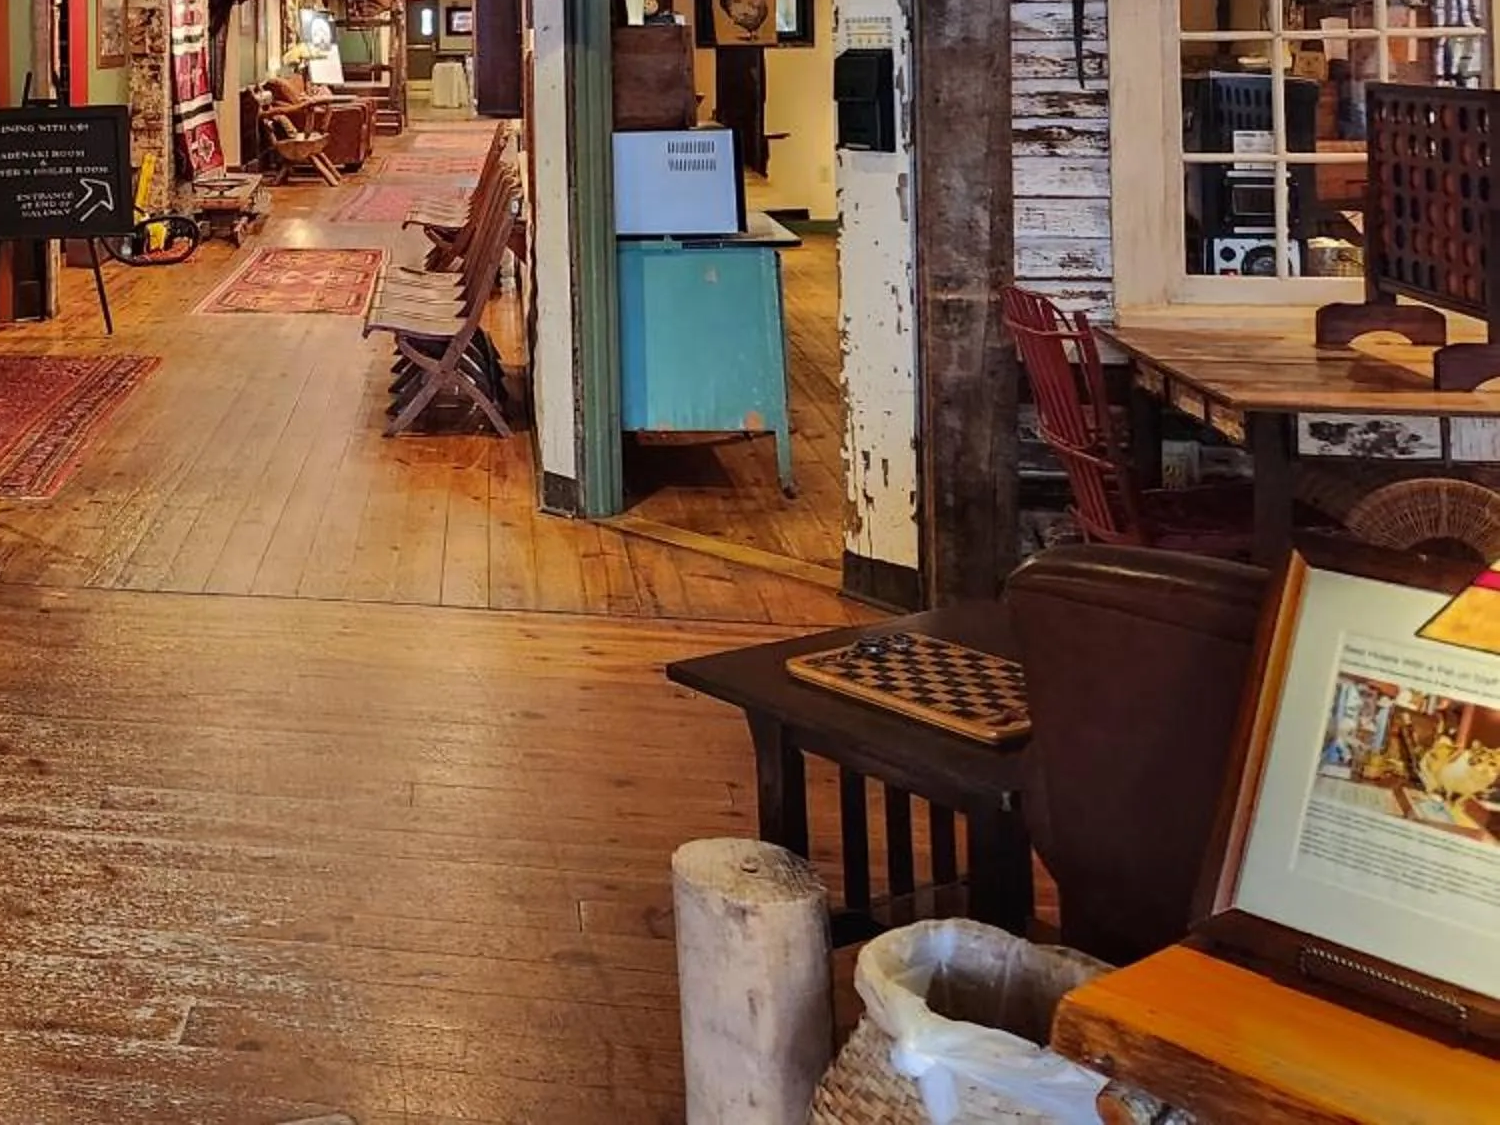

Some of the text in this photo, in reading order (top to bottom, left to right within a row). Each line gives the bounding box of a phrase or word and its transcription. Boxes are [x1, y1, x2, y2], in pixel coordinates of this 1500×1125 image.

[38, 123, 67, 132] WITH
[51, 150, 85, 158] ROOM
[75, 165, 109, 174] ROOM
